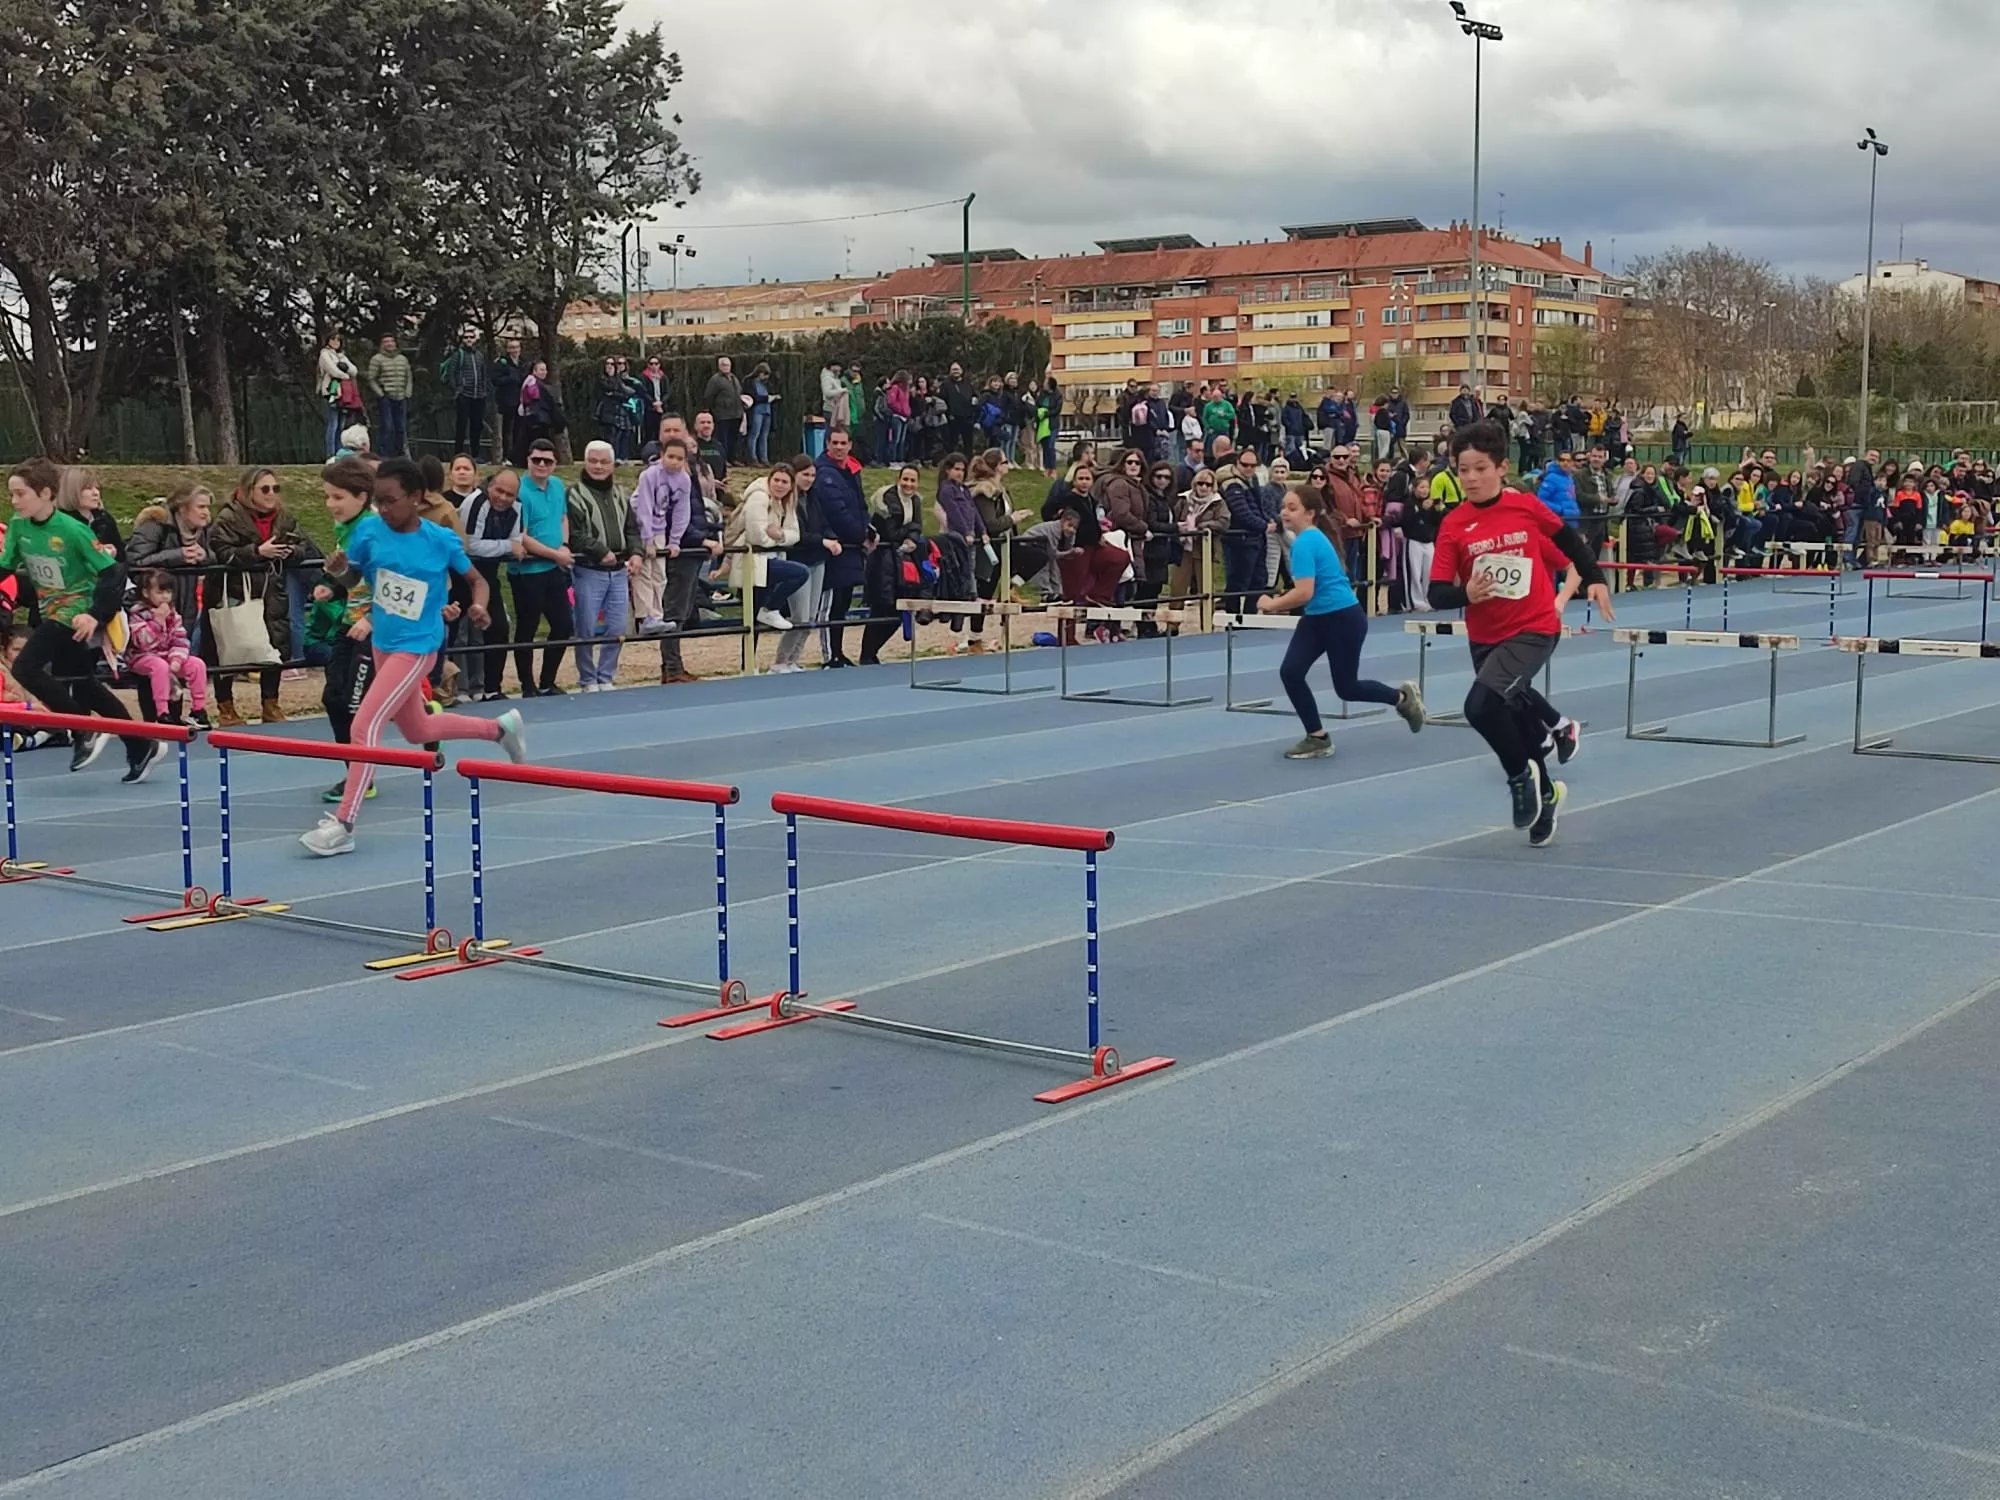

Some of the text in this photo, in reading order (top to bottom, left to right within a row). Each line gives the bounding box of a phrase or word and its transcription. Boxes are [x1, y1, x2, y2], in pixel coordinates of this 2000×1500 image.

[1468, 538, 1495, 556] PEDRO
[1504, 530, 1528, 546] RUBIO
[1483, 565, 1522, 586] 609
[382, 581, 415, 607] 634
[348, 663, 369, 714] Huesca
